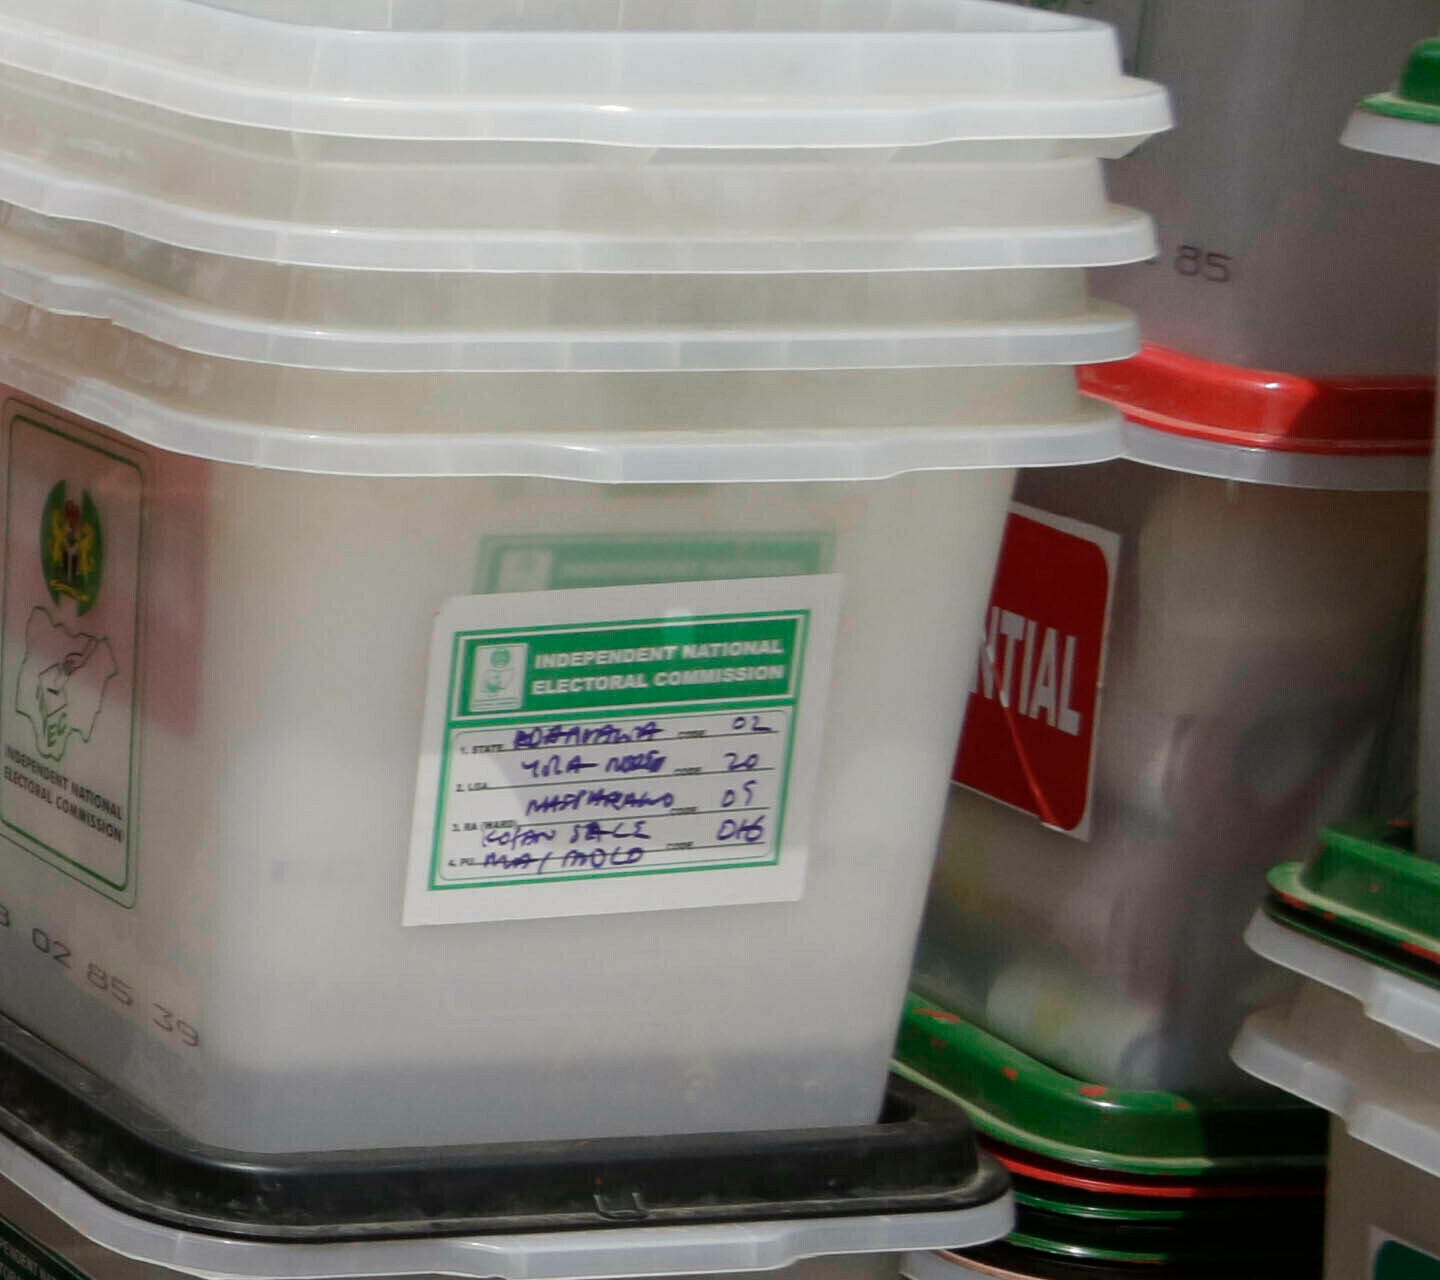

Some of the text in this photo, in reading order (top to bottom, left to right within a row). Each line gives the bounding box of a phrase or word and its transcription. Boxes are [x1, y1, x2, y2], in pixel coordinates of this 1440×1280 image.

[534, 637, 785, 670] INDEPENDENT NATIONAL
[531, 664, 785, 695] ELECTORAL COMMISSION
[471, 744, 505, 754] STATE
[731, 715, 772, 733] 02
[723, 752, 760, 771] 20
[4, 744, 123, 821] INDEPENDENT NATIONAL
[3, 765, 123, 843] ELECTORAL COMMISSION
[32, 927, 72, 970] 02
